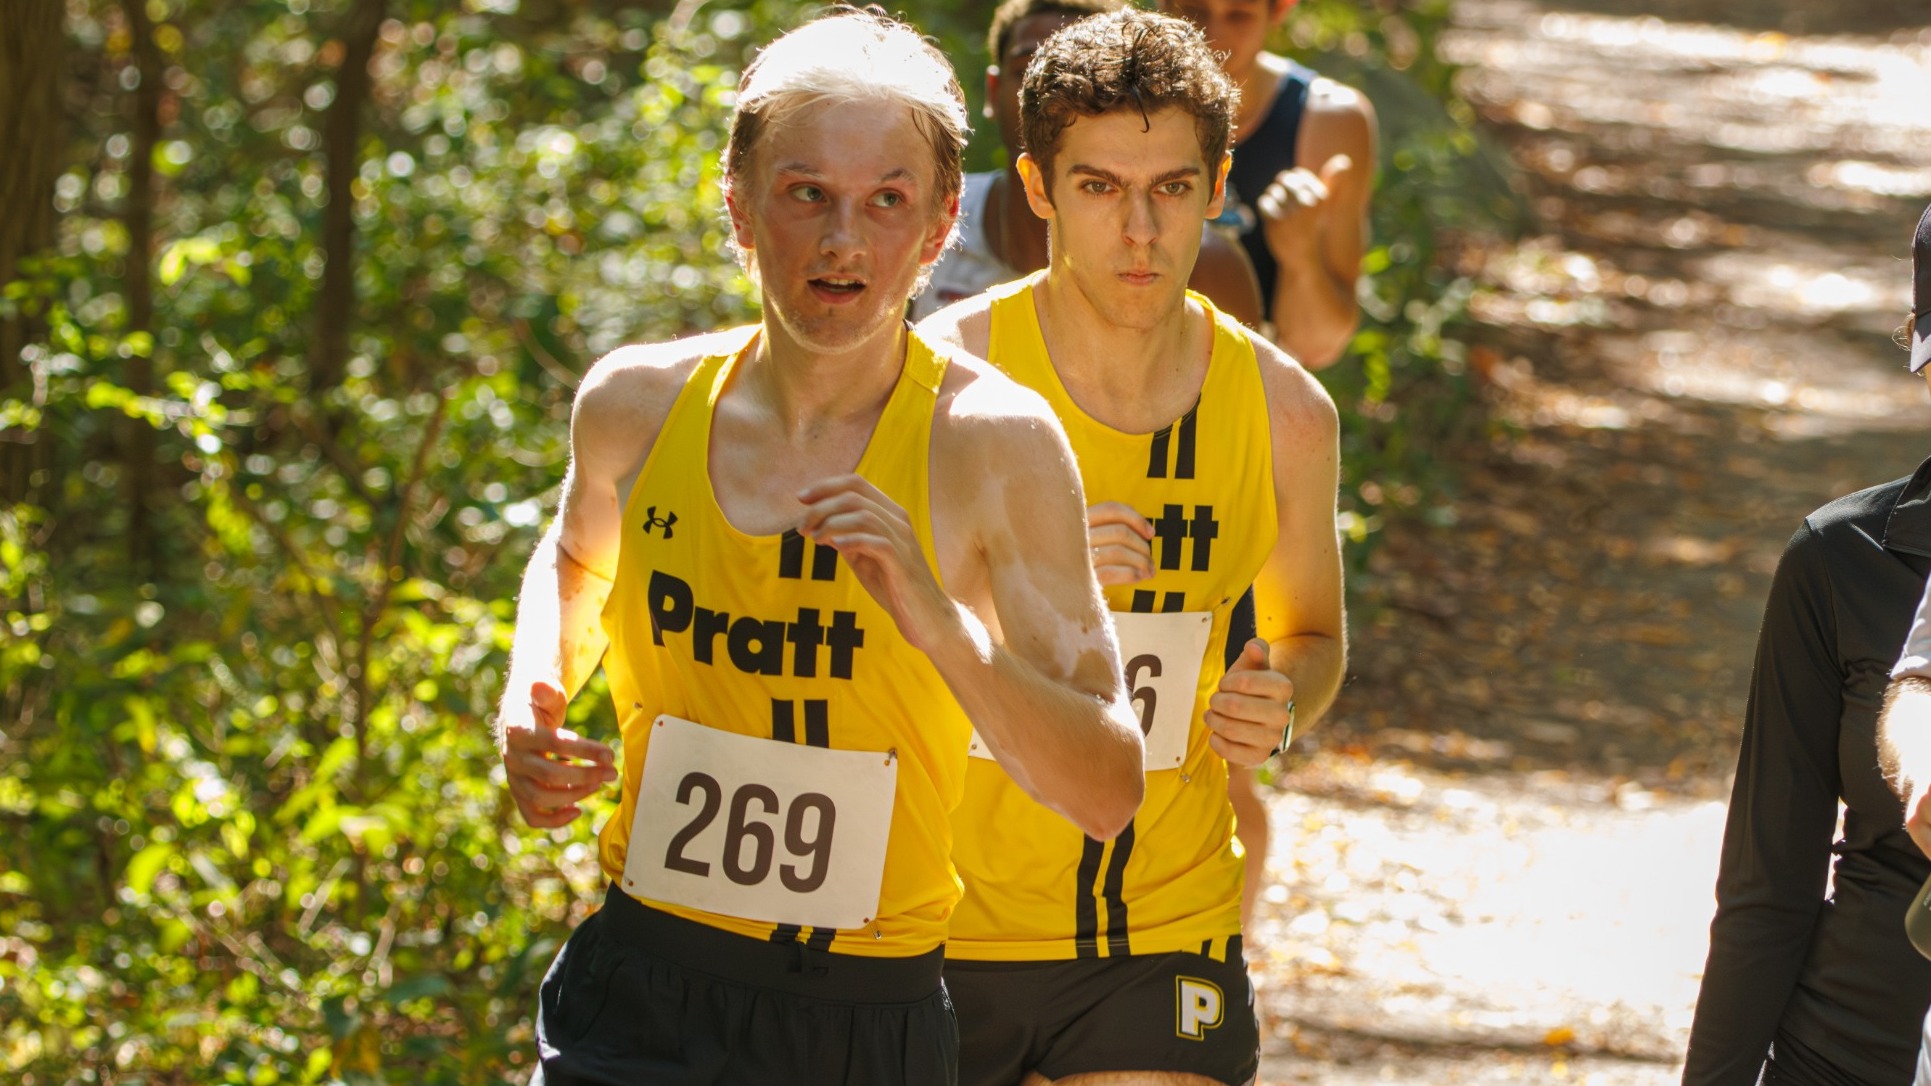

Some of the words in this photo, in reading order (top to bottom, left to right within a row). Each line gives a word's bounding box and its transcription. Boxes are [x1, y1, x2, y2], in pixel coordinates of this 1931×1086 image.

[1145, 504, 1219, 572] tt
[648, 570, 865, 680] Pratt
[664, 772, 837, 894] 269
[1176, 975, 1225, 1041] P
